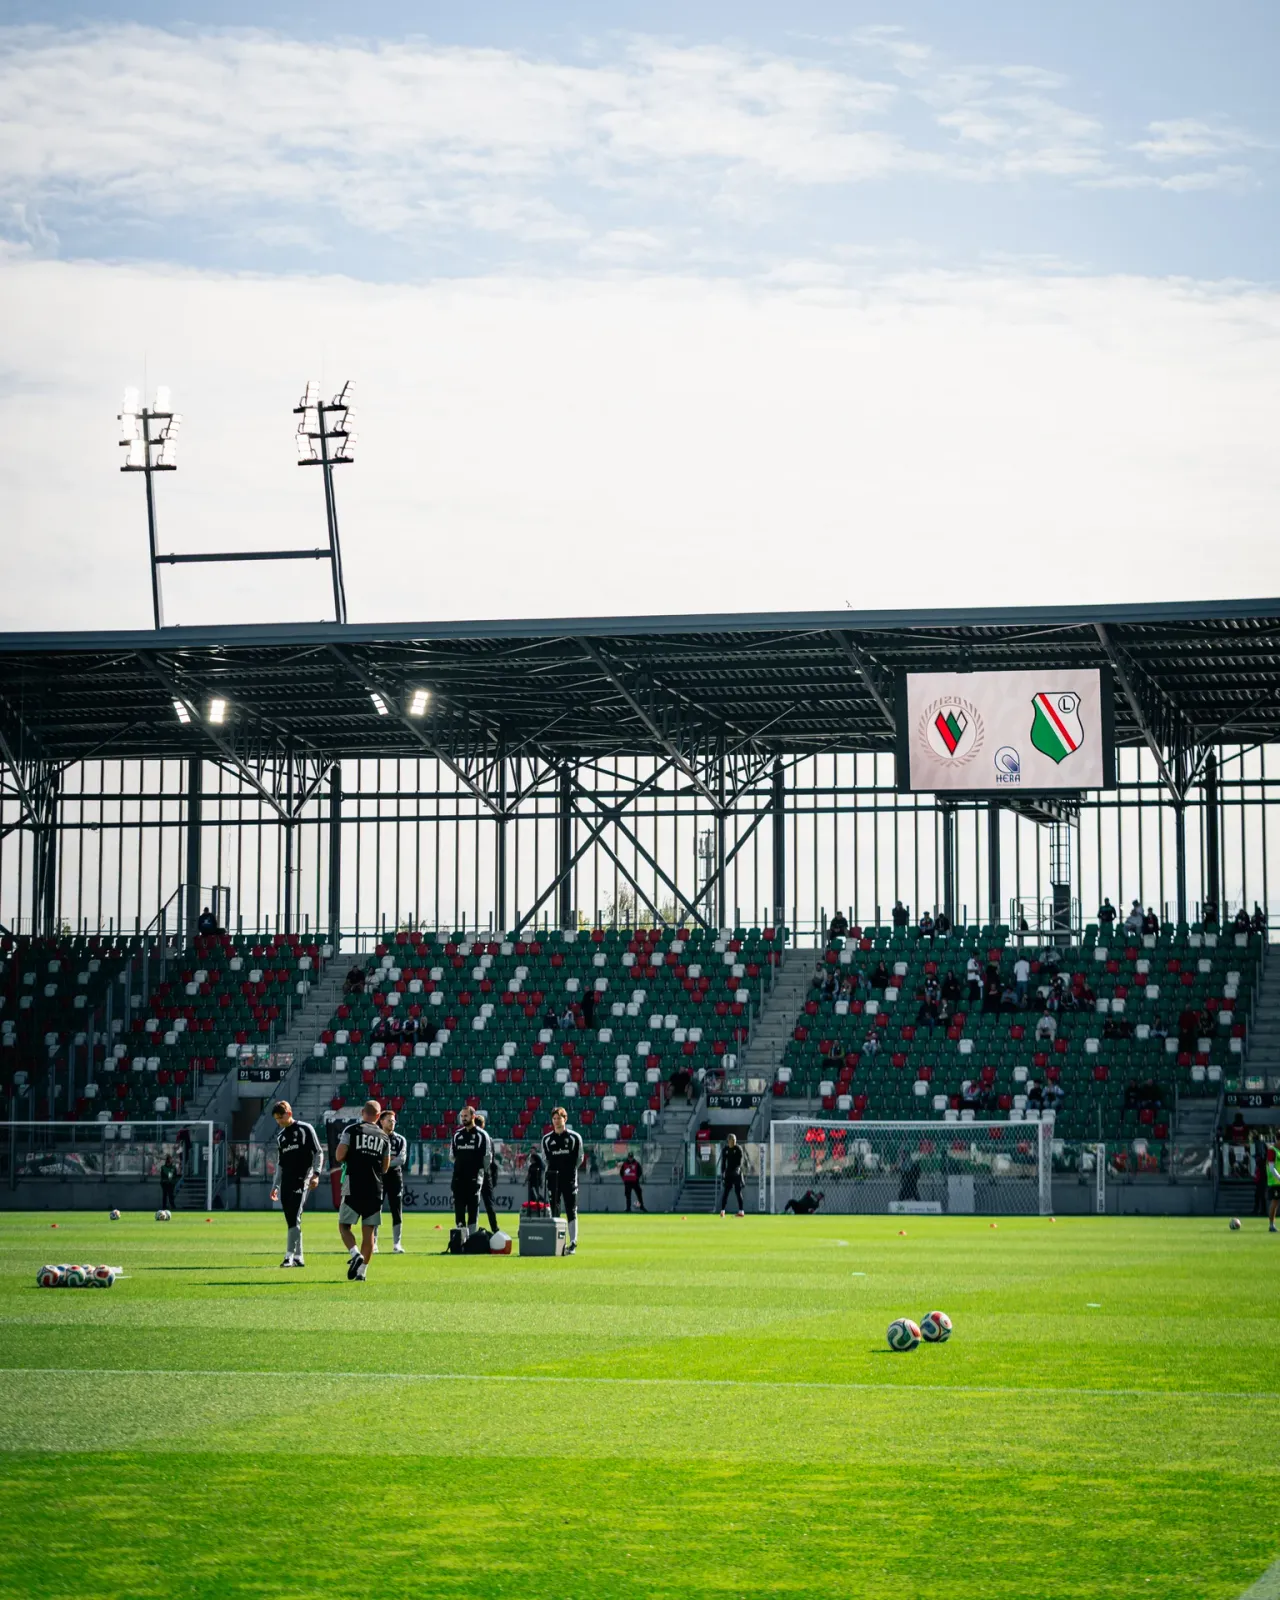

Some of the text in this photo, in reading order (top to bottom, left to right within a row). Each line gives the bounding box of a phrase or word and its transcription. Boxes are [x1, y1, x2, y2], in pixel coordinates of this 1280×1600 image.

[1063, 699, 1071, 710] L
[995, 774, 1021, 783] HERA
[260, 1071, 270, 1080] 18
[730, 1097, 742, 1106] 19
[1249, 1095, 1262, 1105] 20
[356, 1134, 384, 1154] LEGIA
